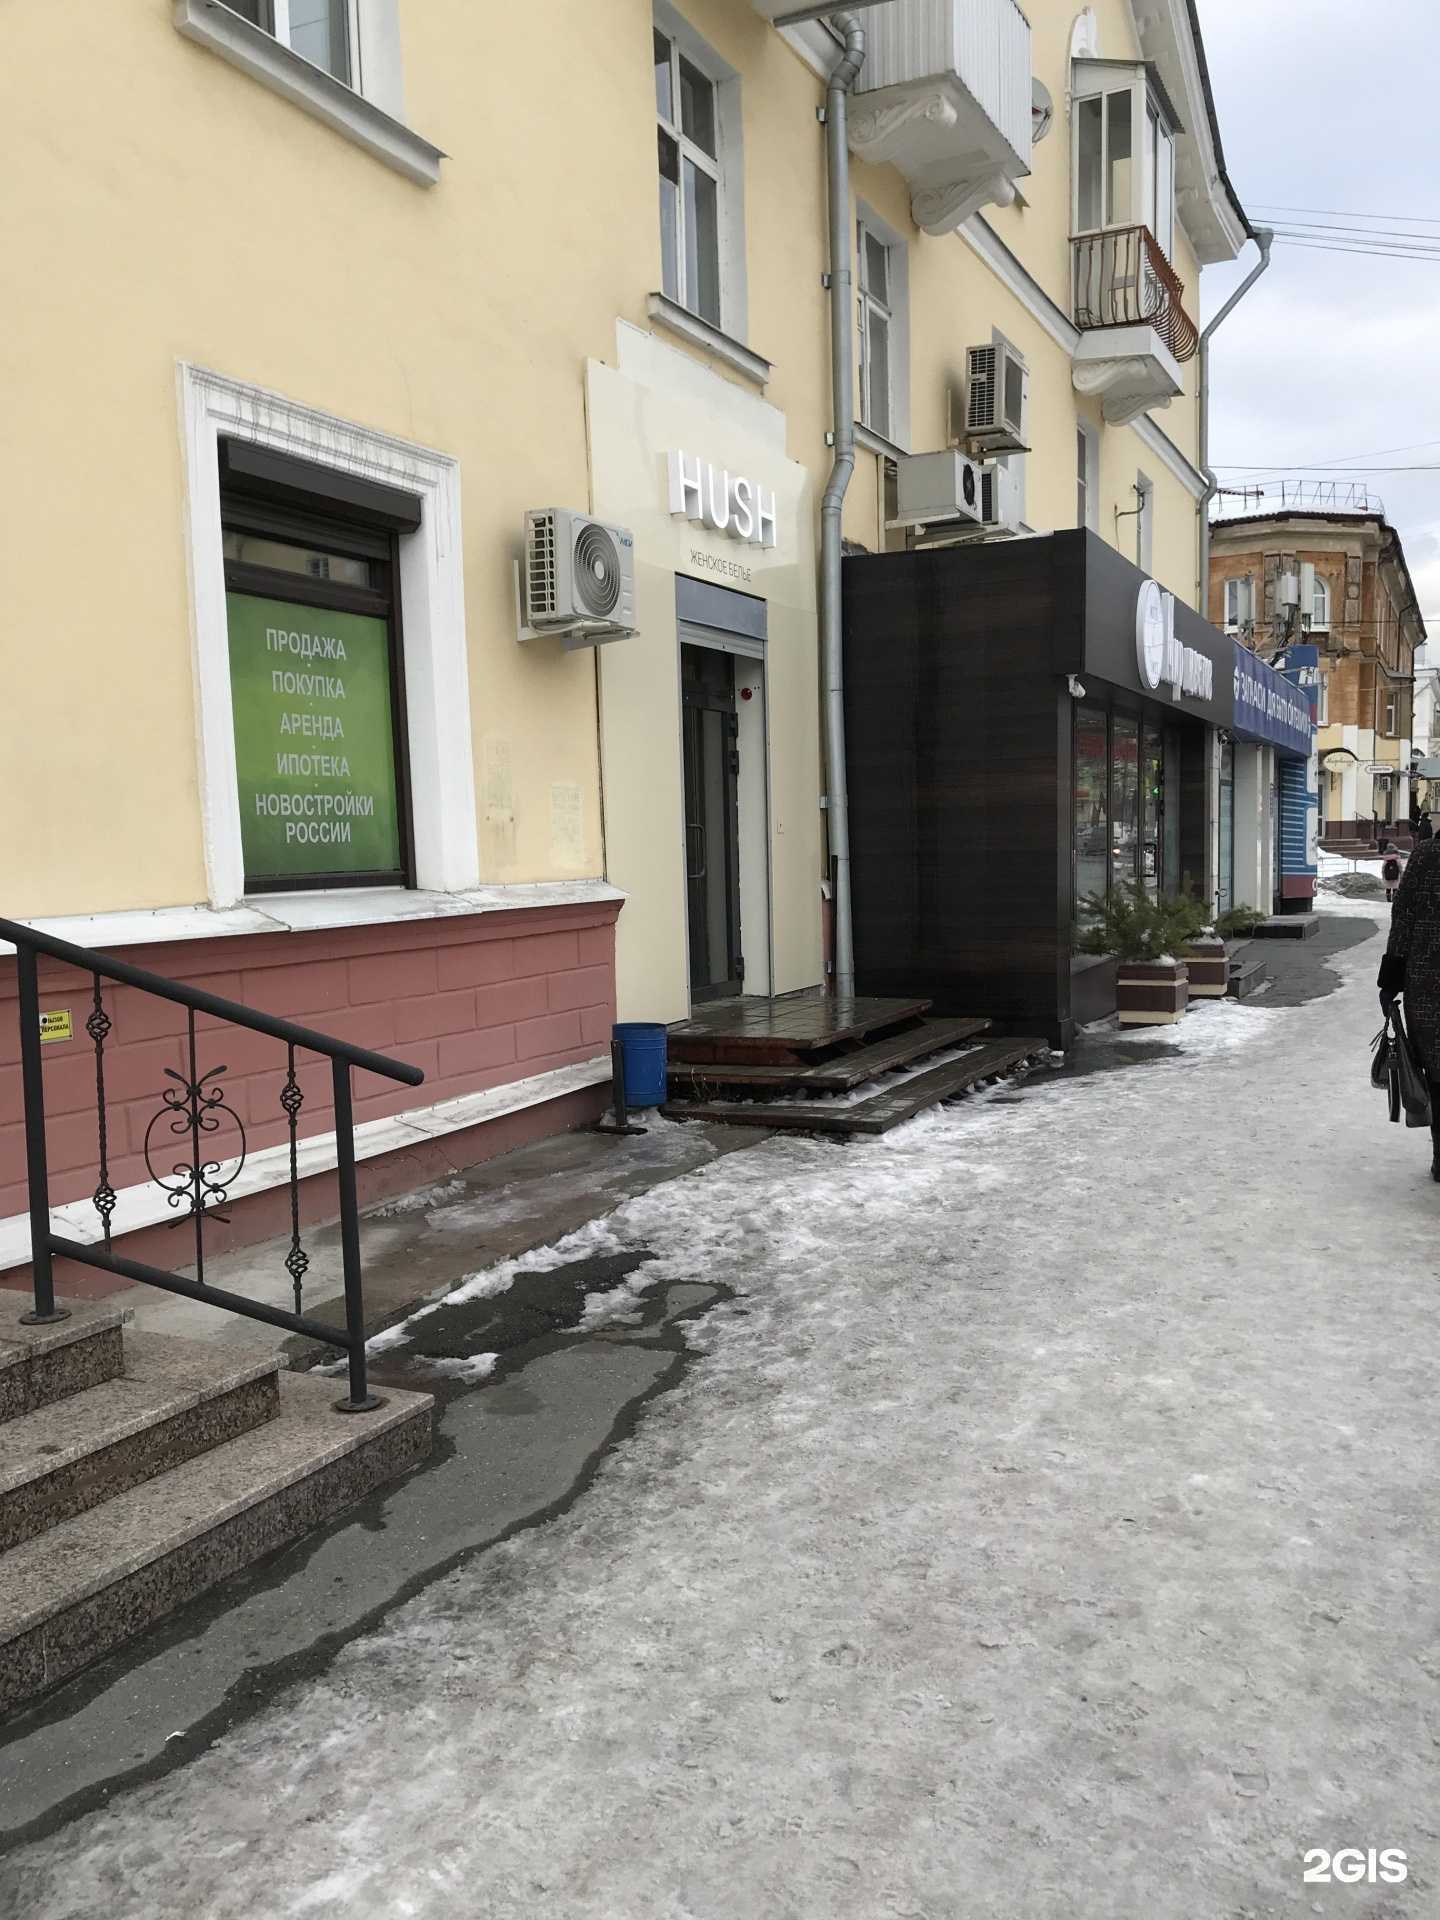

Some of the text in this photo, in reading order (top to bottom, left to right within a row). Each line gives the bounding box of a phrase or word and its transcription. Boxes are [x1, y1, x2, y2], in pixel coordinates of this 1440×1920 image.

[668, 448, 776, 548] HUSH
[690, 549, 752, 582] ЖЕНСКОЕ БЕЛЬЕ
[266, 628, 347, 661] ПРОДАЖА
[271, 669, 346, 698] ПОКУПКА
[280, 712, 344, 741] АРЕНДА
[277, 753, 351, 777] ИПОТЕКА
[255, 790, 374, 816] НОВОСТРОЙКИ
[286, 821, 351, 844] РОССИИ
